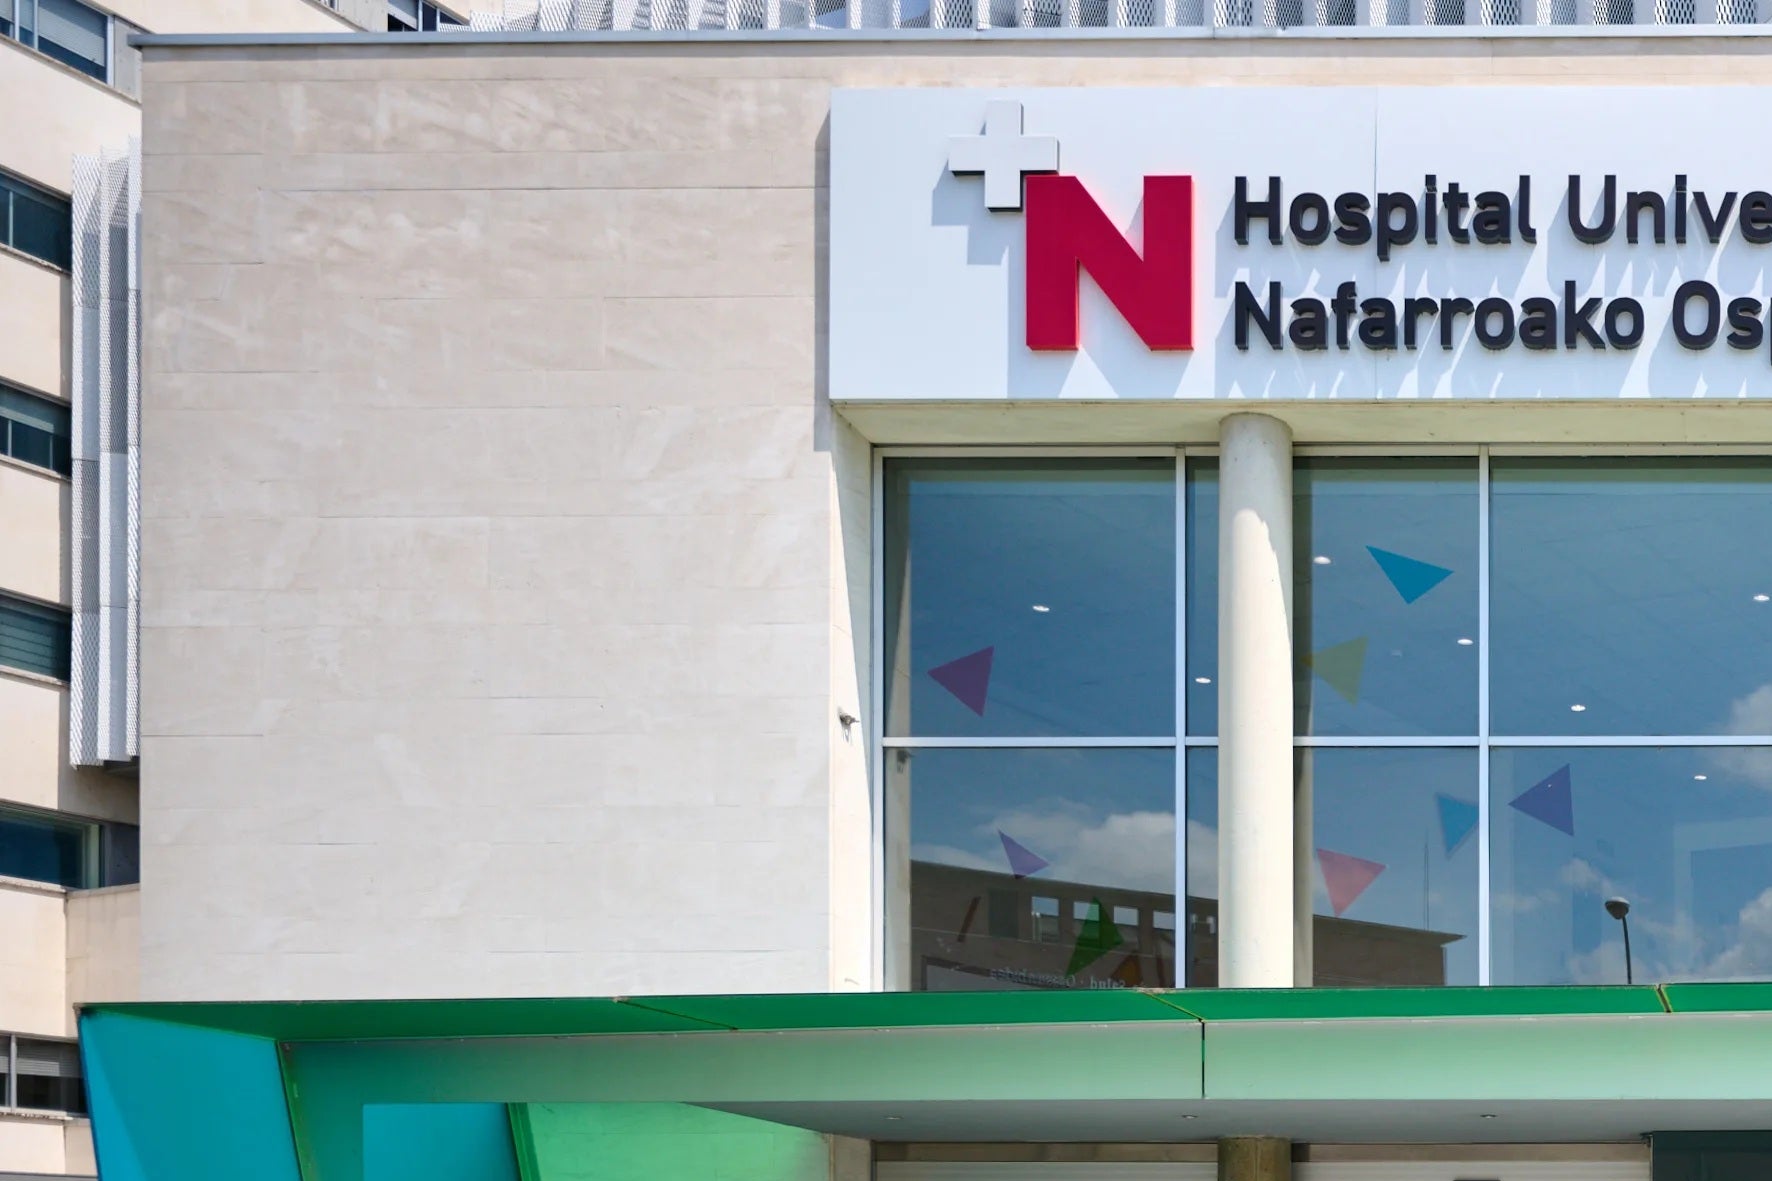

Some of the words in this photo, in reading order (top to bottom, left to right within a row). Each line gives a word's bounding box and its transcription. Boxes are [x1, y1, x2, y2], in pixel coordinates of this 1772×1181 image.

[1026, 174, 1194, 351] N
[1234, 174, 1537, 263] Hospital
[1234, 280, 1646, 352] Nafarroako
